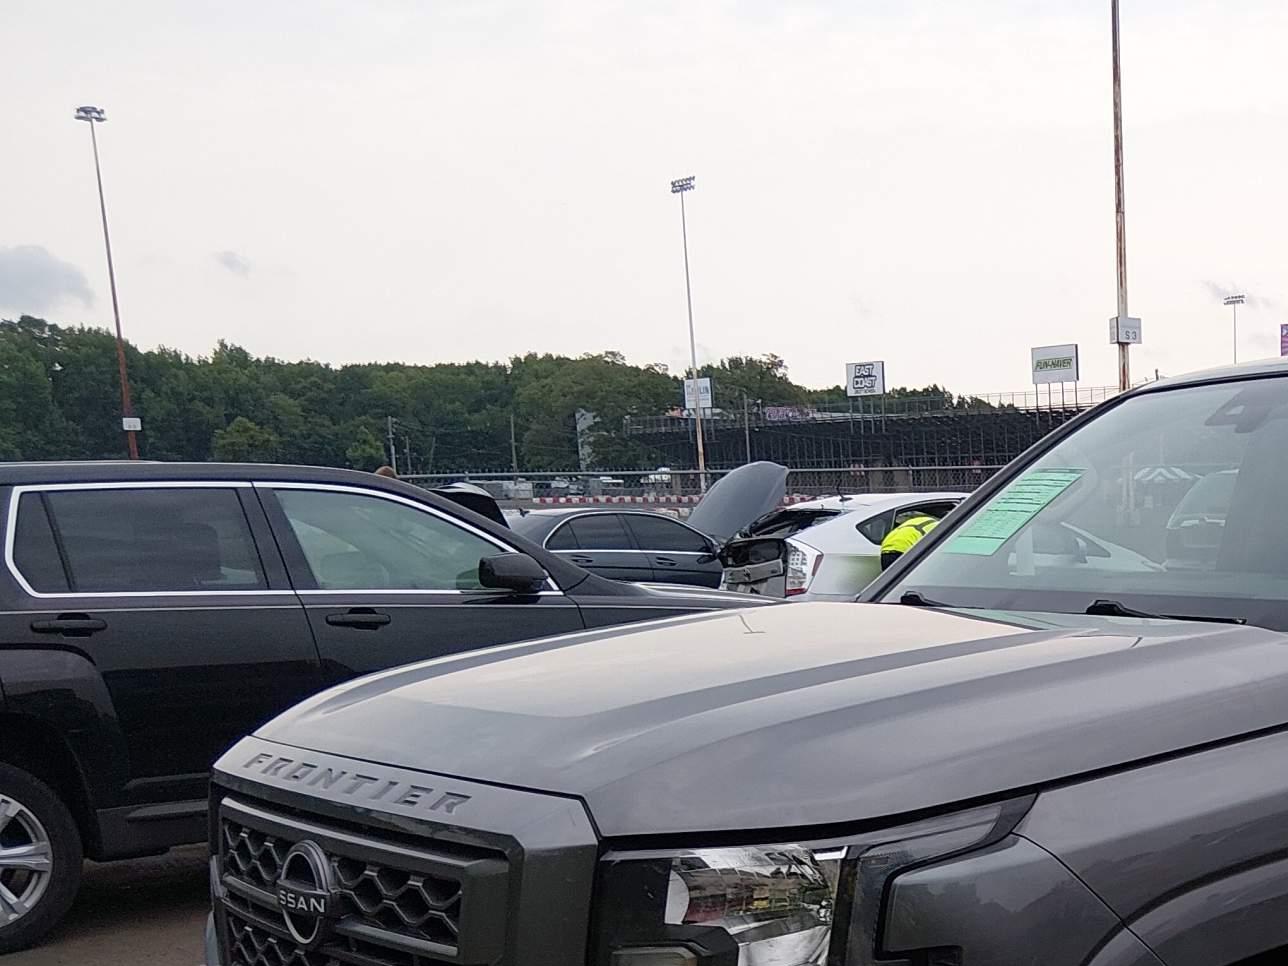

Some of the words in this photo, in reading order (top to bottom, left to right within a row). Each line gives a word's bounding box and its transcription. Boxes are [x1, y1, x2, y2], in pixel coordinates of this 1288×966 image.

[855, 364, 875, 377] EAST
[853, 375, 877, 389] COAST
[243, 752, 472, 815] FRONTIER
[280, 890, 325, 912] SSAN
